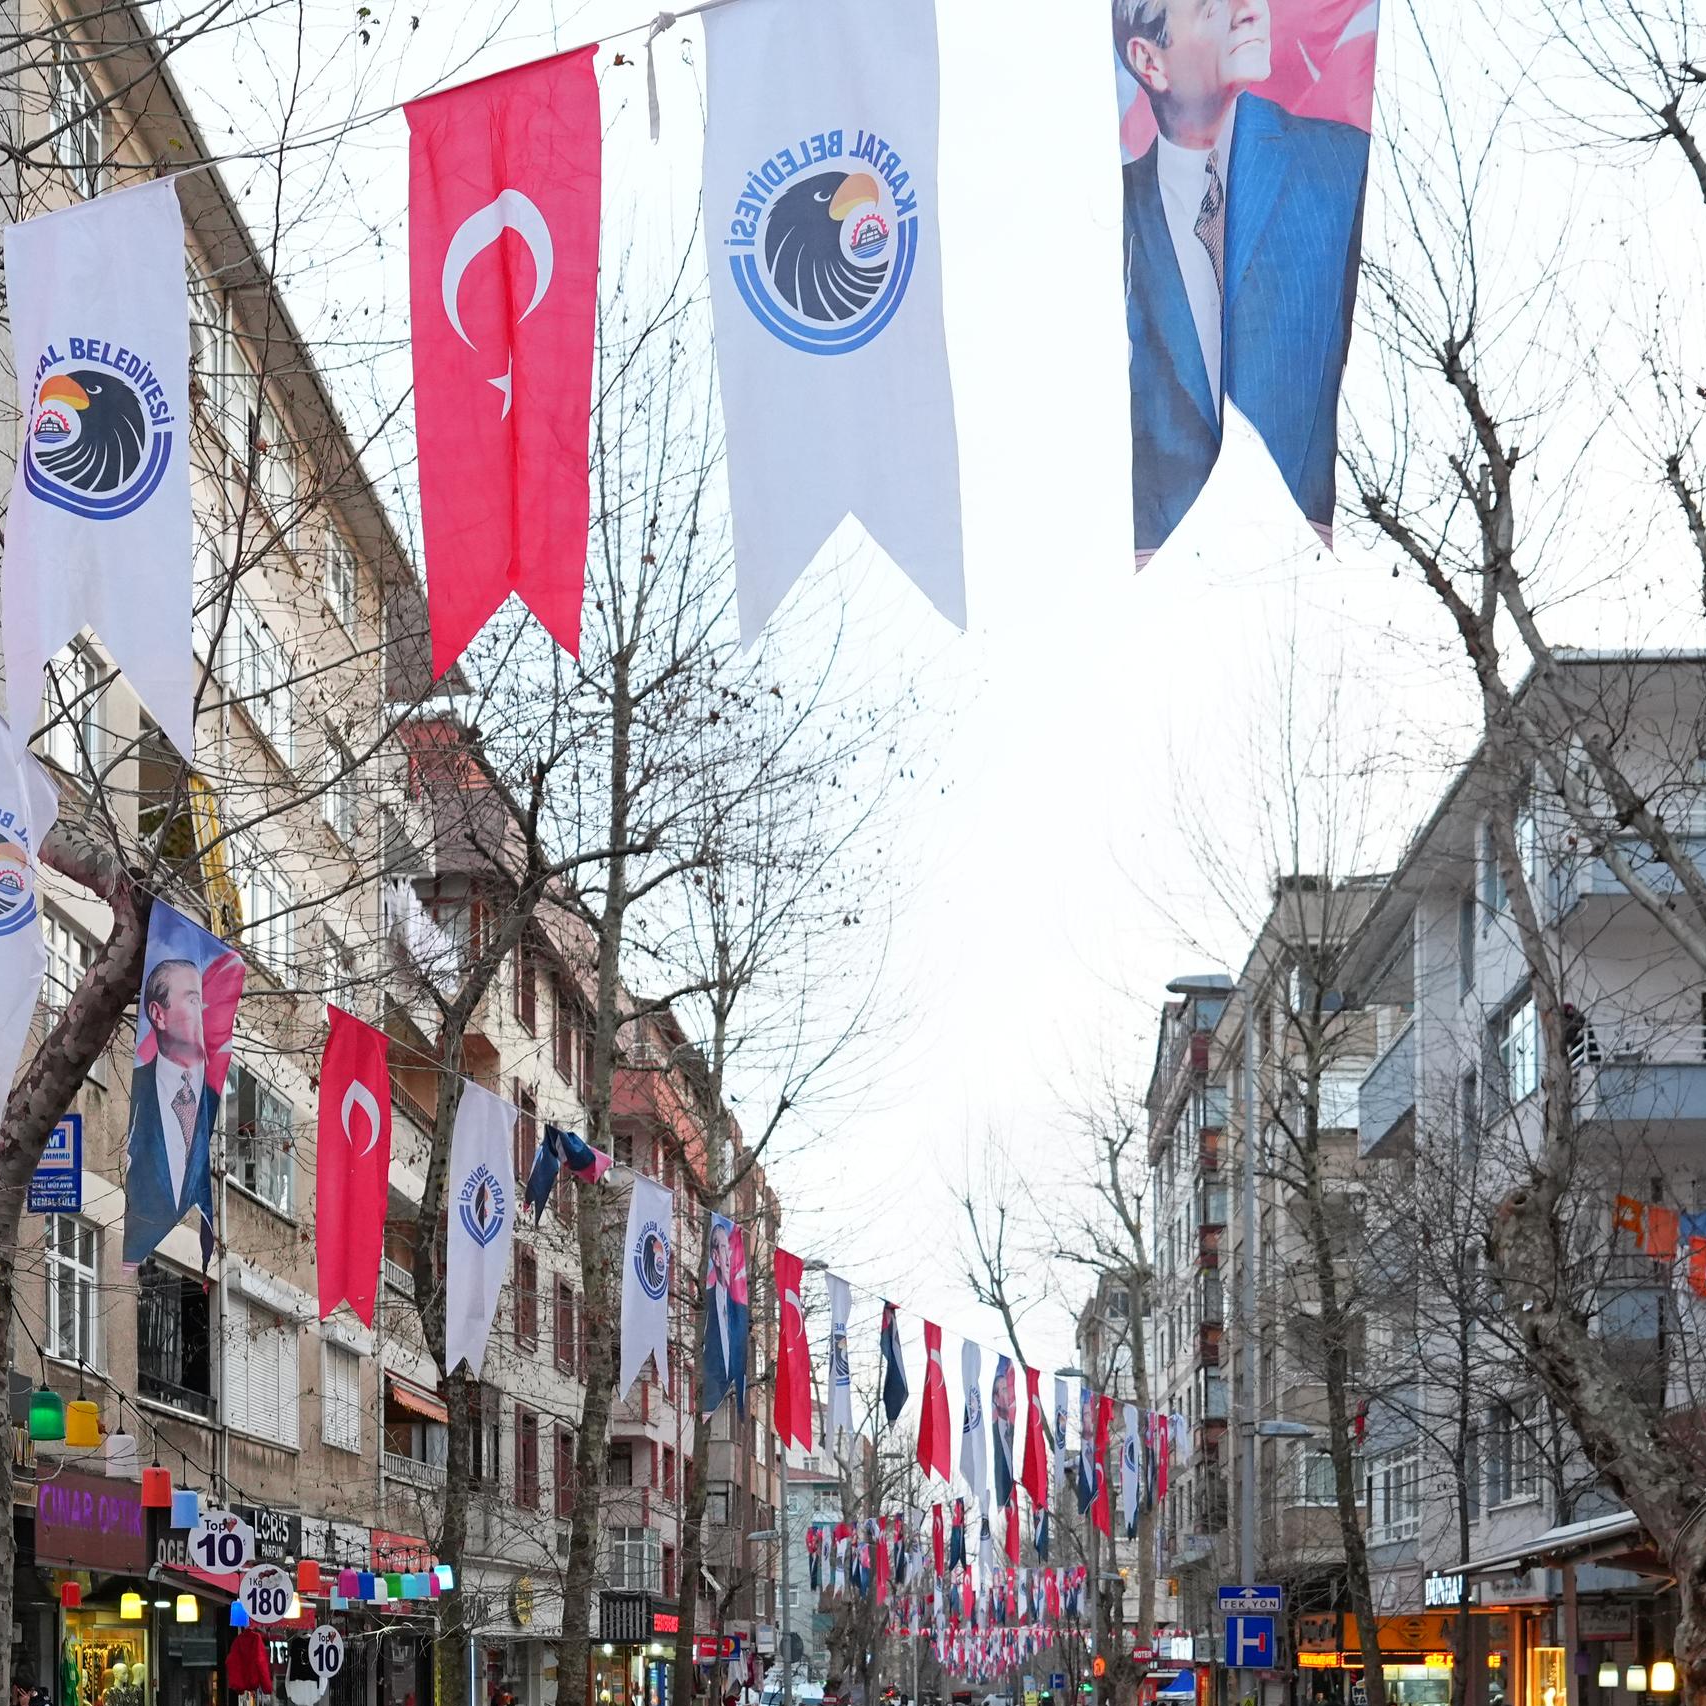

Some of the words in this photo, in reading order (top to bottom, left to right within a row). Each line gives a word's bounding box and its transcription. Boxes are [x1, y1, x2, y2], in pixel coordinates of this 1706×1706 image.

[68, 337, 176, 427] BELEDİYESİ
[204, 1520, 227, 1534] Top
[197, 1533, 243, 1567] 10
[247, 1587, 287, 1616] 180
[1223, 1599, 1246, 1609] TEK
[313, 1644, 339, 1672] 10
[1133, 1649, 1153, 1660] NOTER
